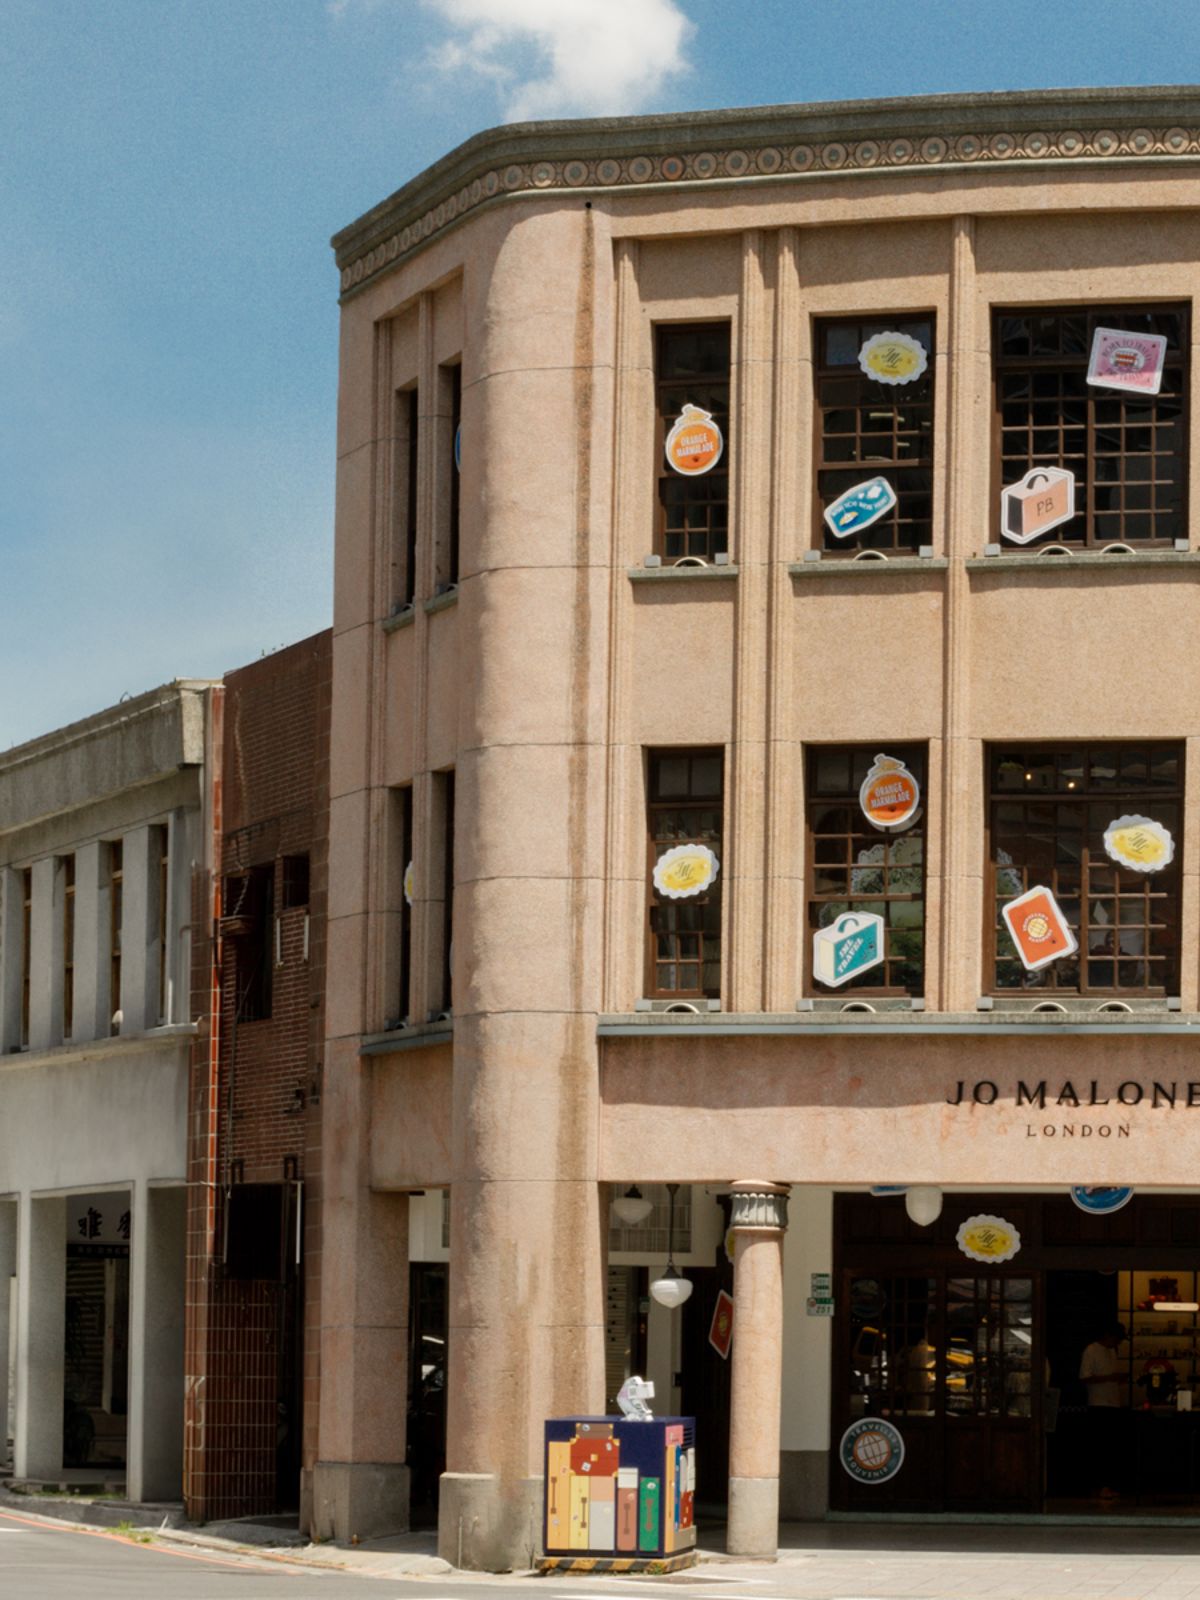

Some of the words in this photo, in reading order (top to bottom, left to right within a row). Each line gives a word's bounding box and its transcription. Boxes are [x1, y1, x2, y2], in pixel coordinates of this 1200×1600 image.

[1036, 497, 1055, 517] PB
[837, 937, 864, 974] TRAVEL
[946, 1080, 999, 1106] JO
[1026, 1122, 1131, 1138] LONDON
[847, 1455, 888, 1478] SOUVENIR
